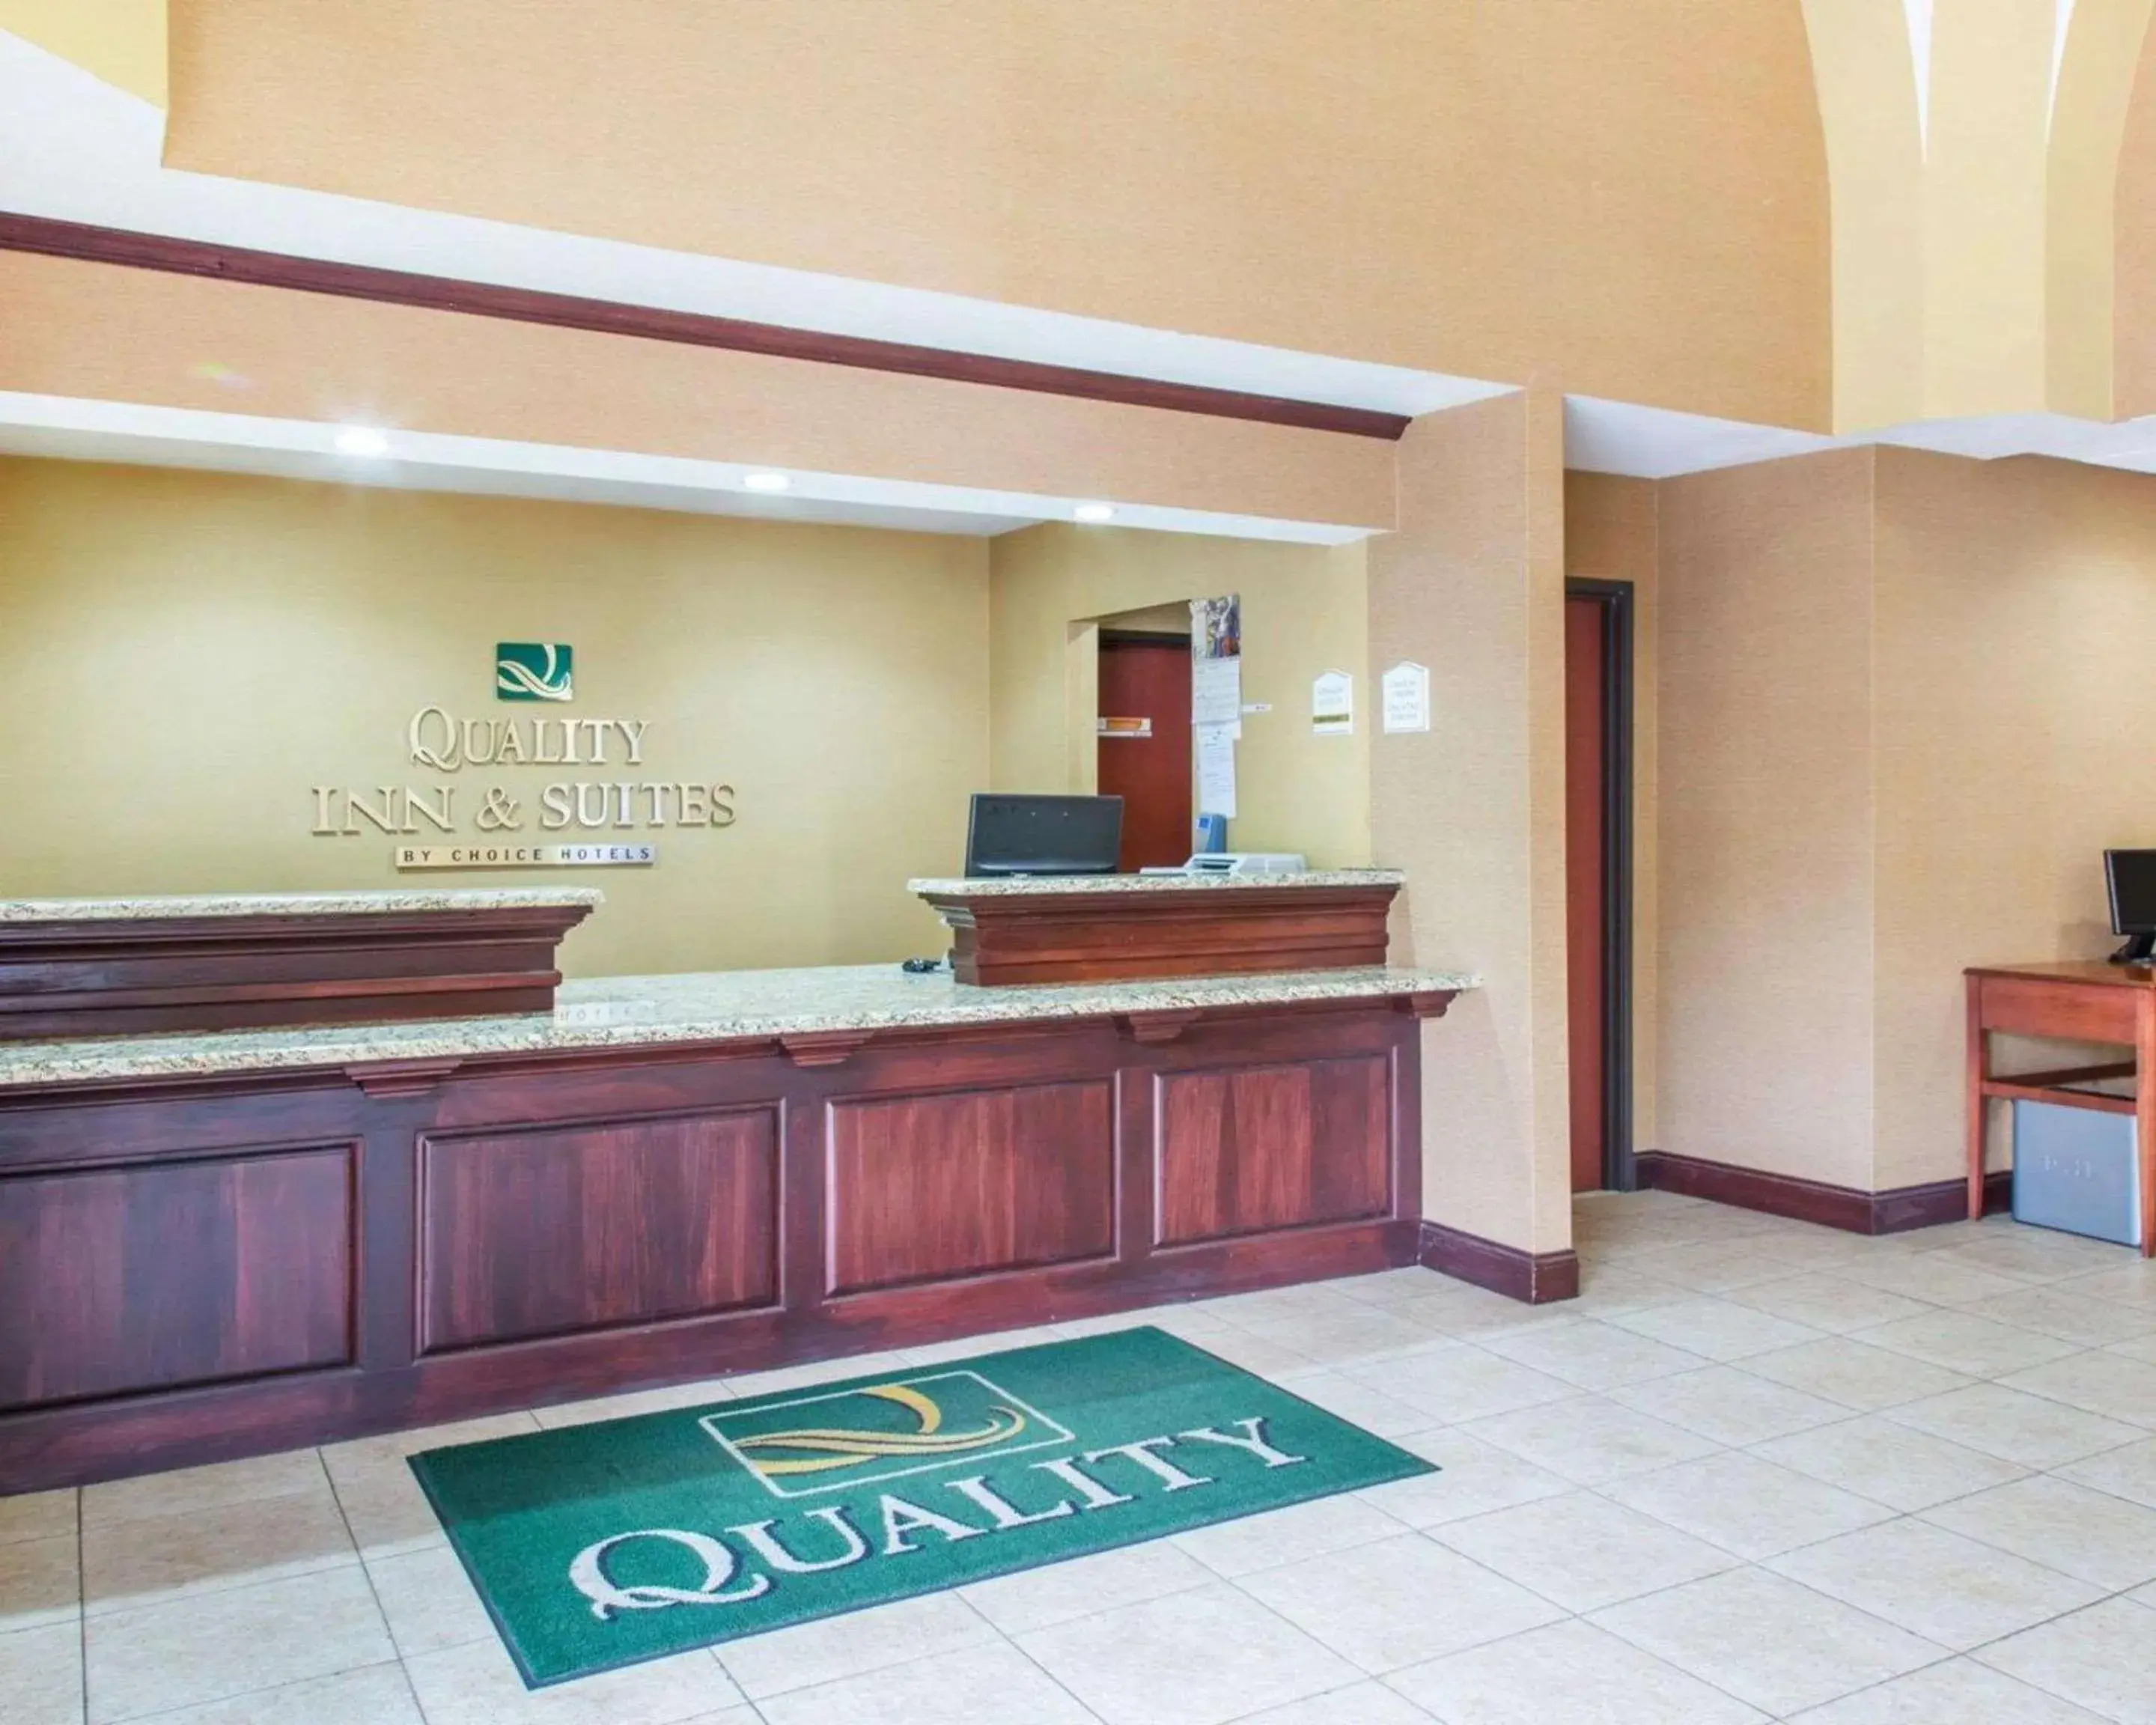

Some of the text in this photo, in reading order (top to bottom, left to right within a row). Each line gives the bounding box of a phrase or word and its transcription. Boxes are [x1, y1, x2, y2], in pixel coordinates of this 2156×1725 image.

[409, 706, 649, 772] QUALITY
[311, 782, 737, 836] INN & SUITES
[404, 847, 651, 862] BY CHOICE HOTELS
[568, 1417, 1306, 1622] QUALITY
